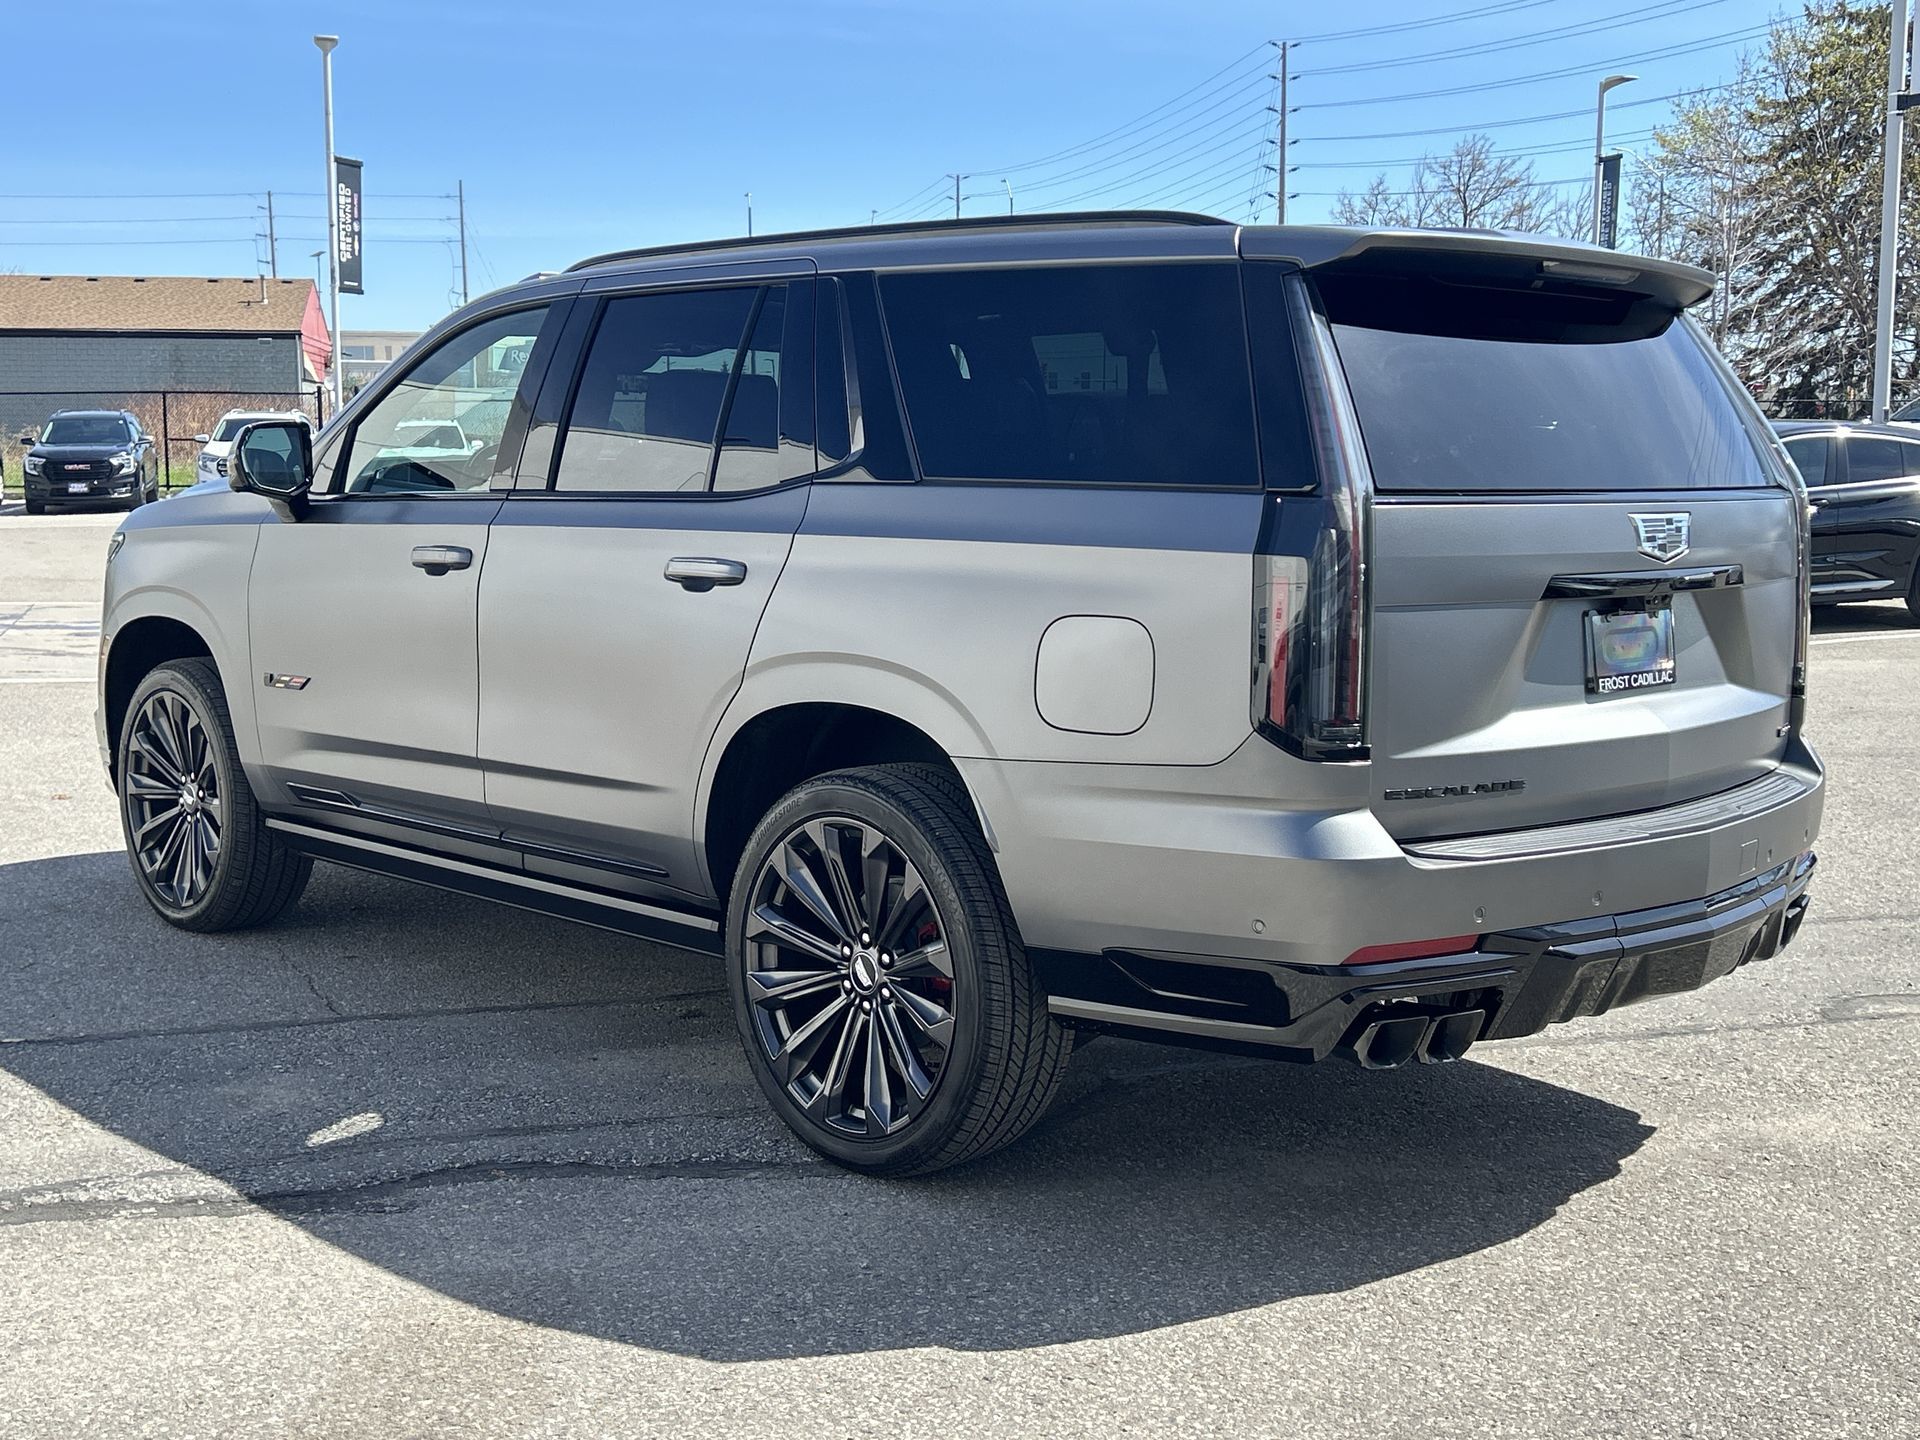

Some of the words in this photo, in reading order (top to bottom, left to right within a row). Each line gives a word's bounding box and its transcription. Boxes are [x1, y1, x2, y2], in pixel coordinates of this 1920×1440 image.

[338, 183, 347, 262] CERTIFIED
[1599, 675, 1630, 692] FROST
[1631, 671, 1674, 687] CADILLAC
[1385, 779, 1527, 801] ESCALADE
[754, 797, 802, 847] BRIDGESTONE
